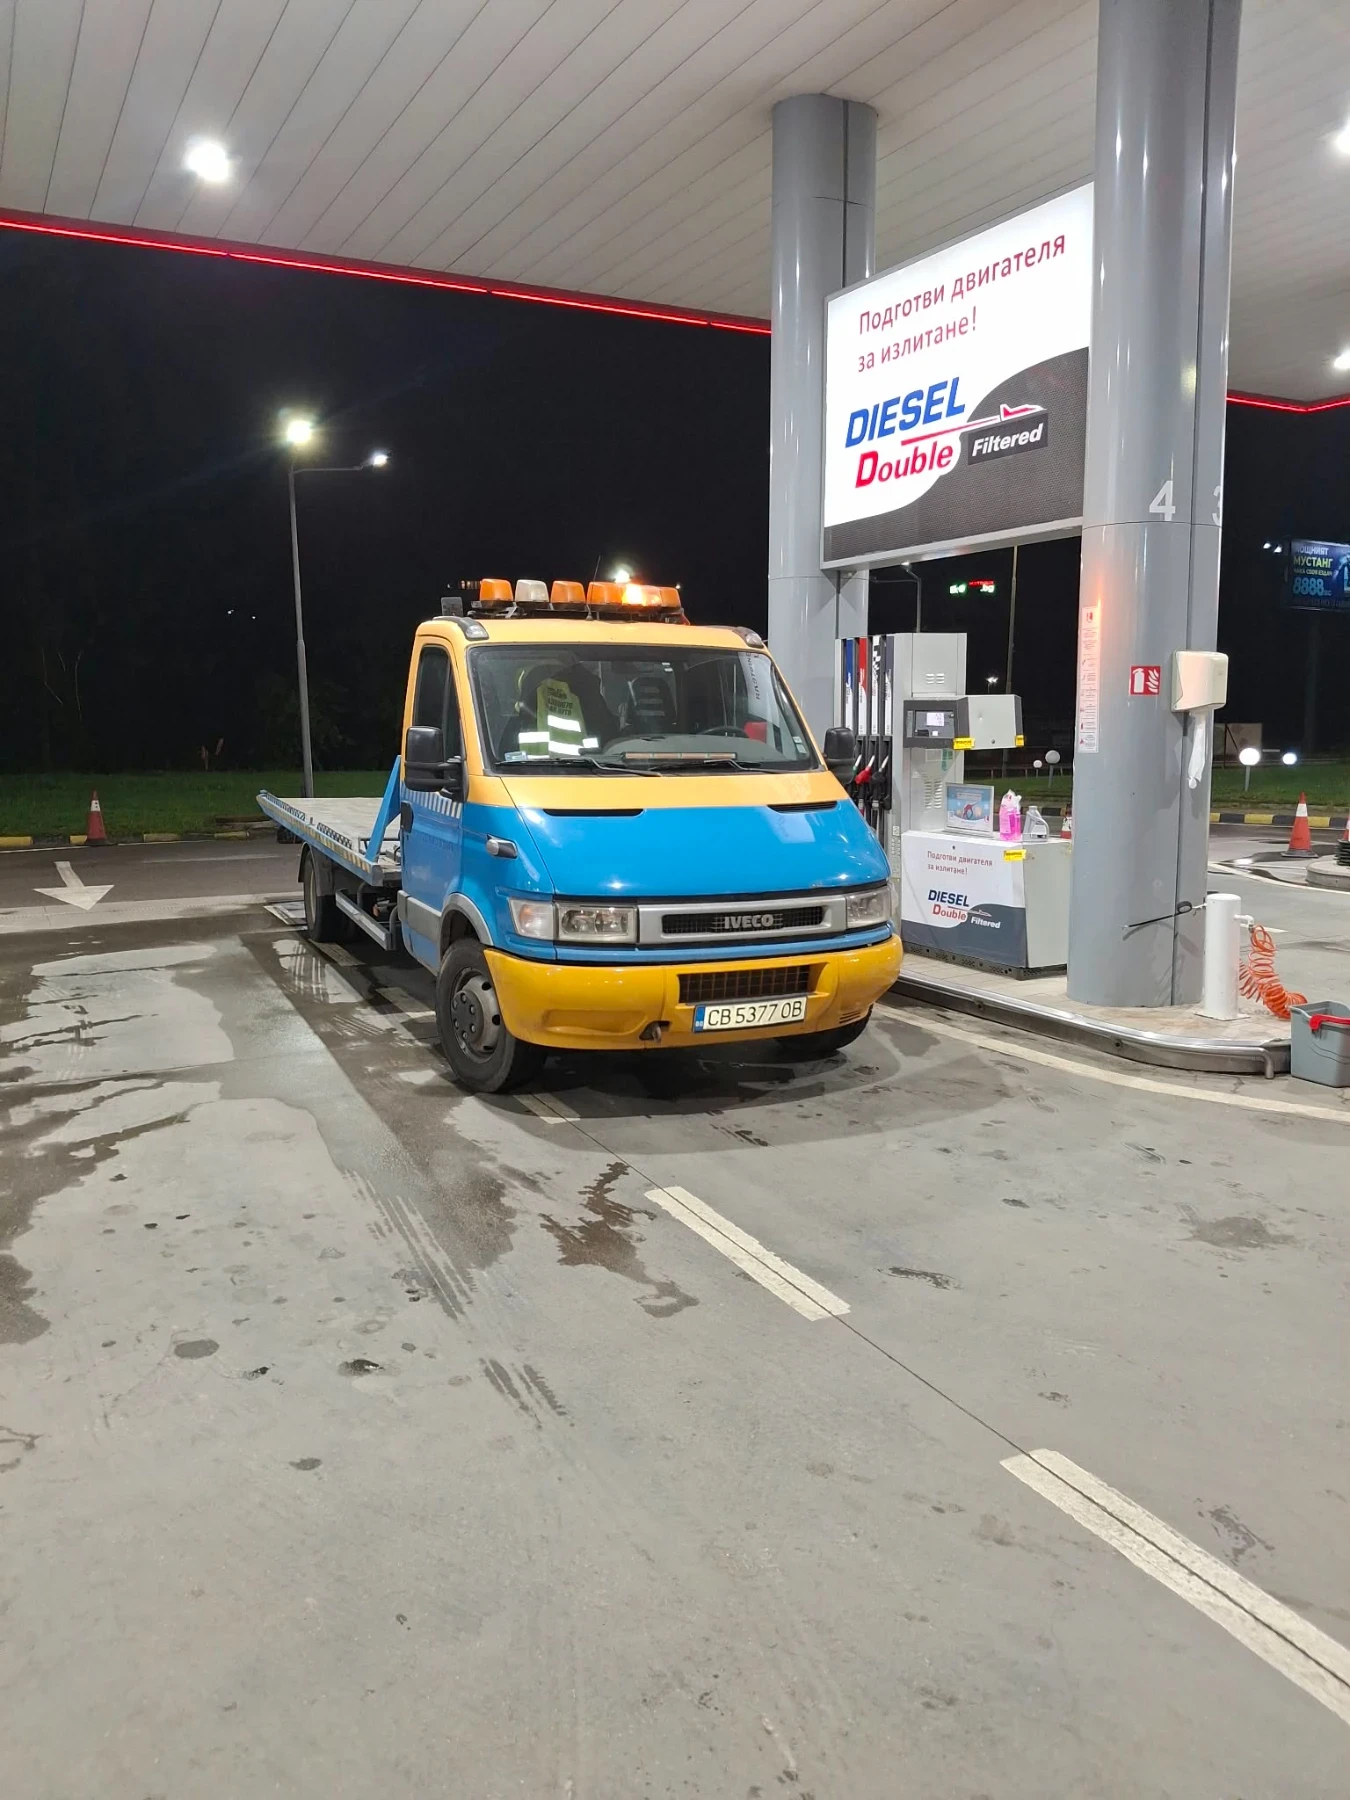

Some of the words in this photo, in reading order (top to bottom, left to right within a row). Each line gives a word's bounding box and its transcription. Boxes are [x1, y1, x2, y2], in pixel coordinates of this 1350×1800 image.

[859, 285, 945, 335] Подготви
[951, 234, 1066, 302] двигателя
[857, 352, 875, 373] за
[881, 306, 978, 363] излитане!
[845, 376, 966, 449] DIESEL
[971, 423, 1044, 457] Filtered
[855, 441, 954, 489] Double
[1149, 480, 1176, 521] 4
[1293, 555, 1333, 569] МУСТАНГ
[927, 850, 957, 861] Подготви
[958, 856, 993, 867] двигателя
[935, 865, 968, 876] излитане!
[928, 889, 970, 907] DIESEL
[724, 913, 774, 929] IVECO
[932, 903, 967, 921] Double
[970, 916, 1002, 929] Filtered
[708, 1008, 732, 1026] CB
[735, 1003, 778, 1024] 5377
